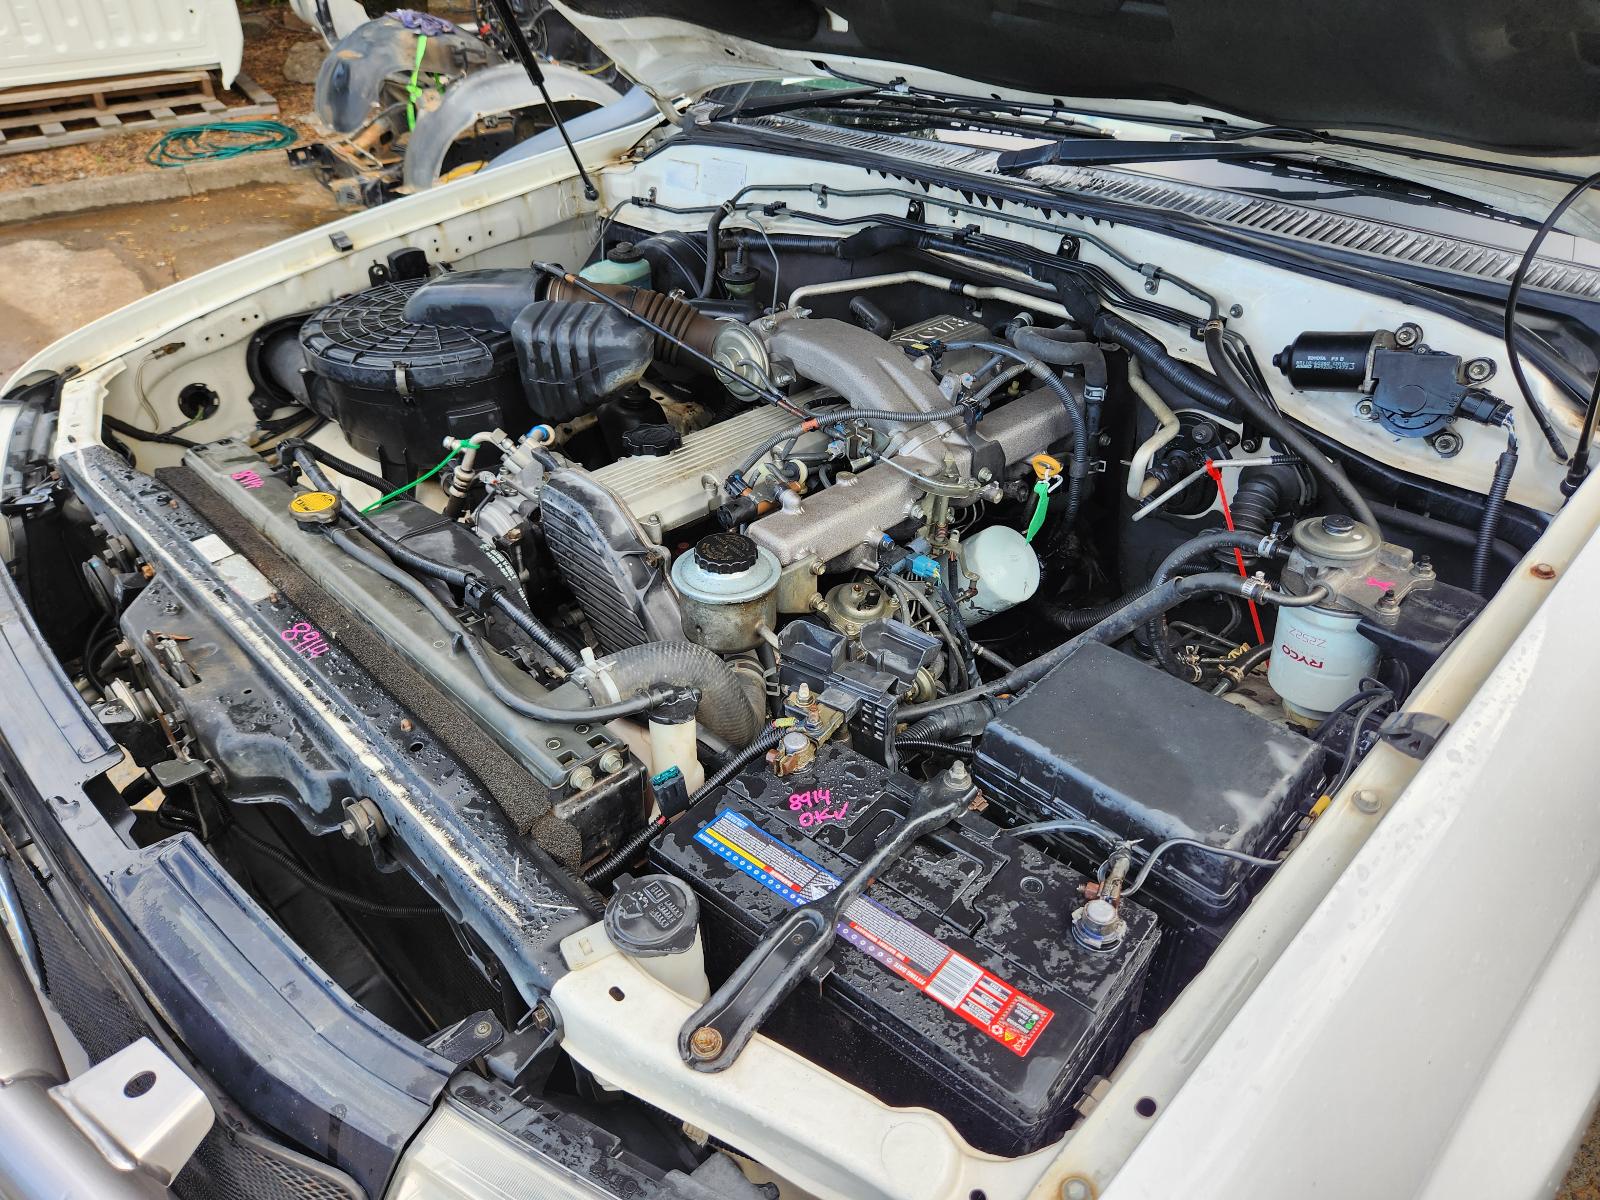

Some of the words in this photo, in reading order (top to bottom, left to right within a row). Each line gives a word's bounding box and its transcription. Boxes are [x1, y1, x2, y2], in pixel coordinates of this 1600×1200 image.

[281, 621, 330, 661] 8914
[1282, 644, 1324, 669] RYCO
[788, 787, 832, 811] 8914
